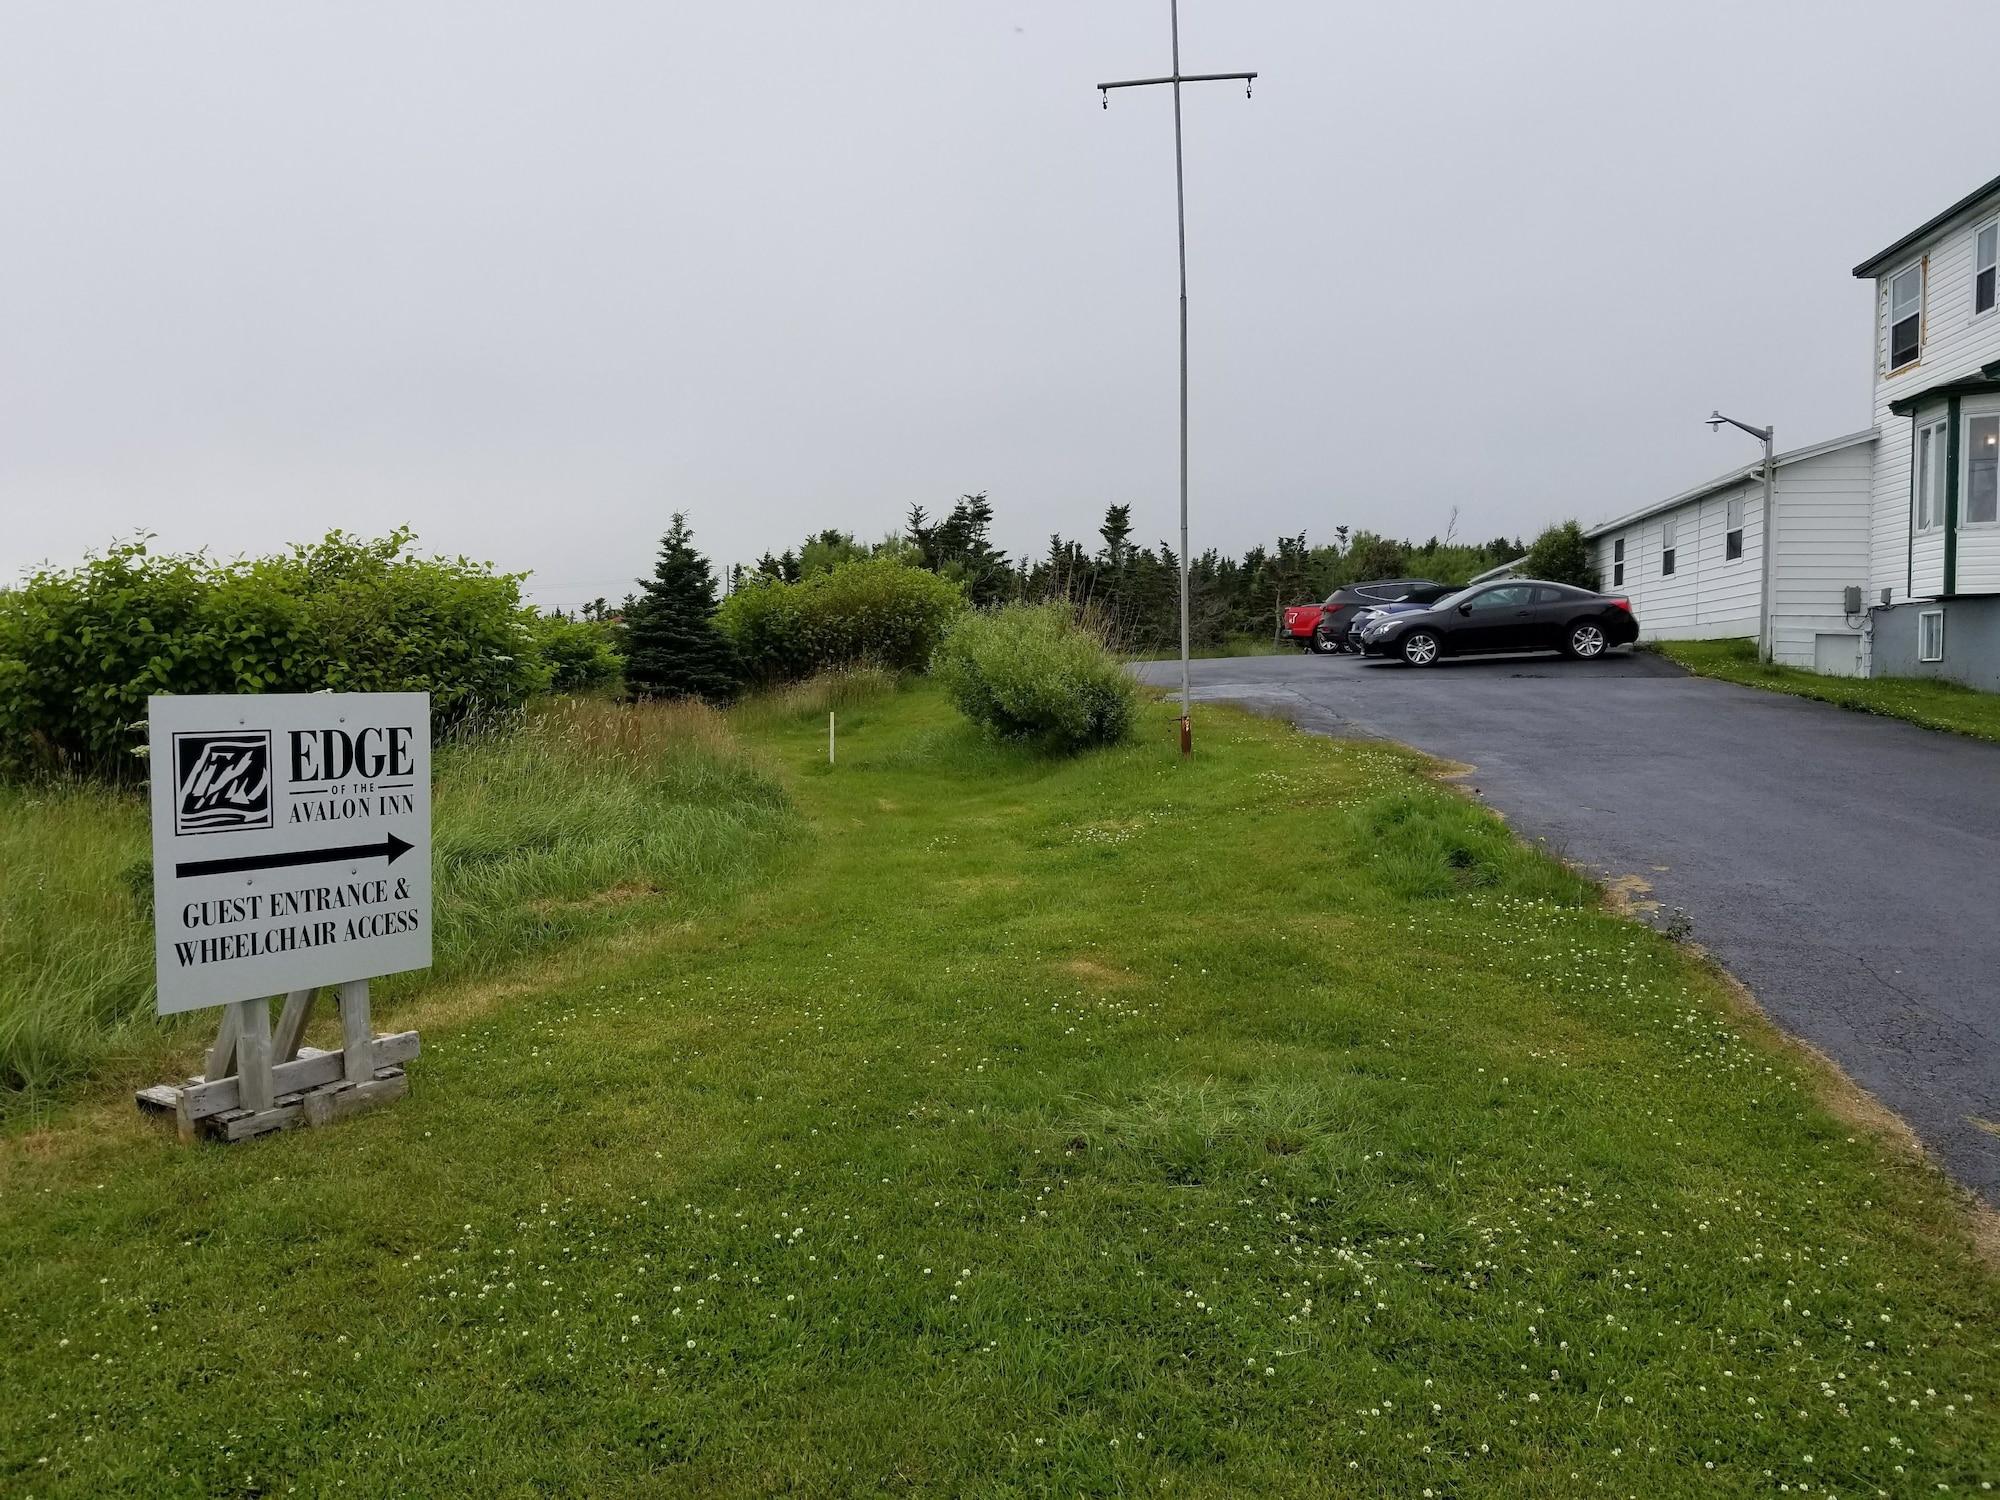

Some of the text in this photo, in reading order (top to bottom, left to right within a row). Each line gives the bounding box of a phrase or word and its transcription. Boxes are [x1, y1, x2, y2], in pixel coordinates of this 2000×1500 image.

[287, 726, 414, 782] EDGE
[288, 794, 414, 823] AVALON INN
[331, 783, 375, 795] OF THE
[182, 877, 411, 929] GUEST ENTRANCE &
[174, 908, 419, 968] WHEELCHAIR ACCESS
